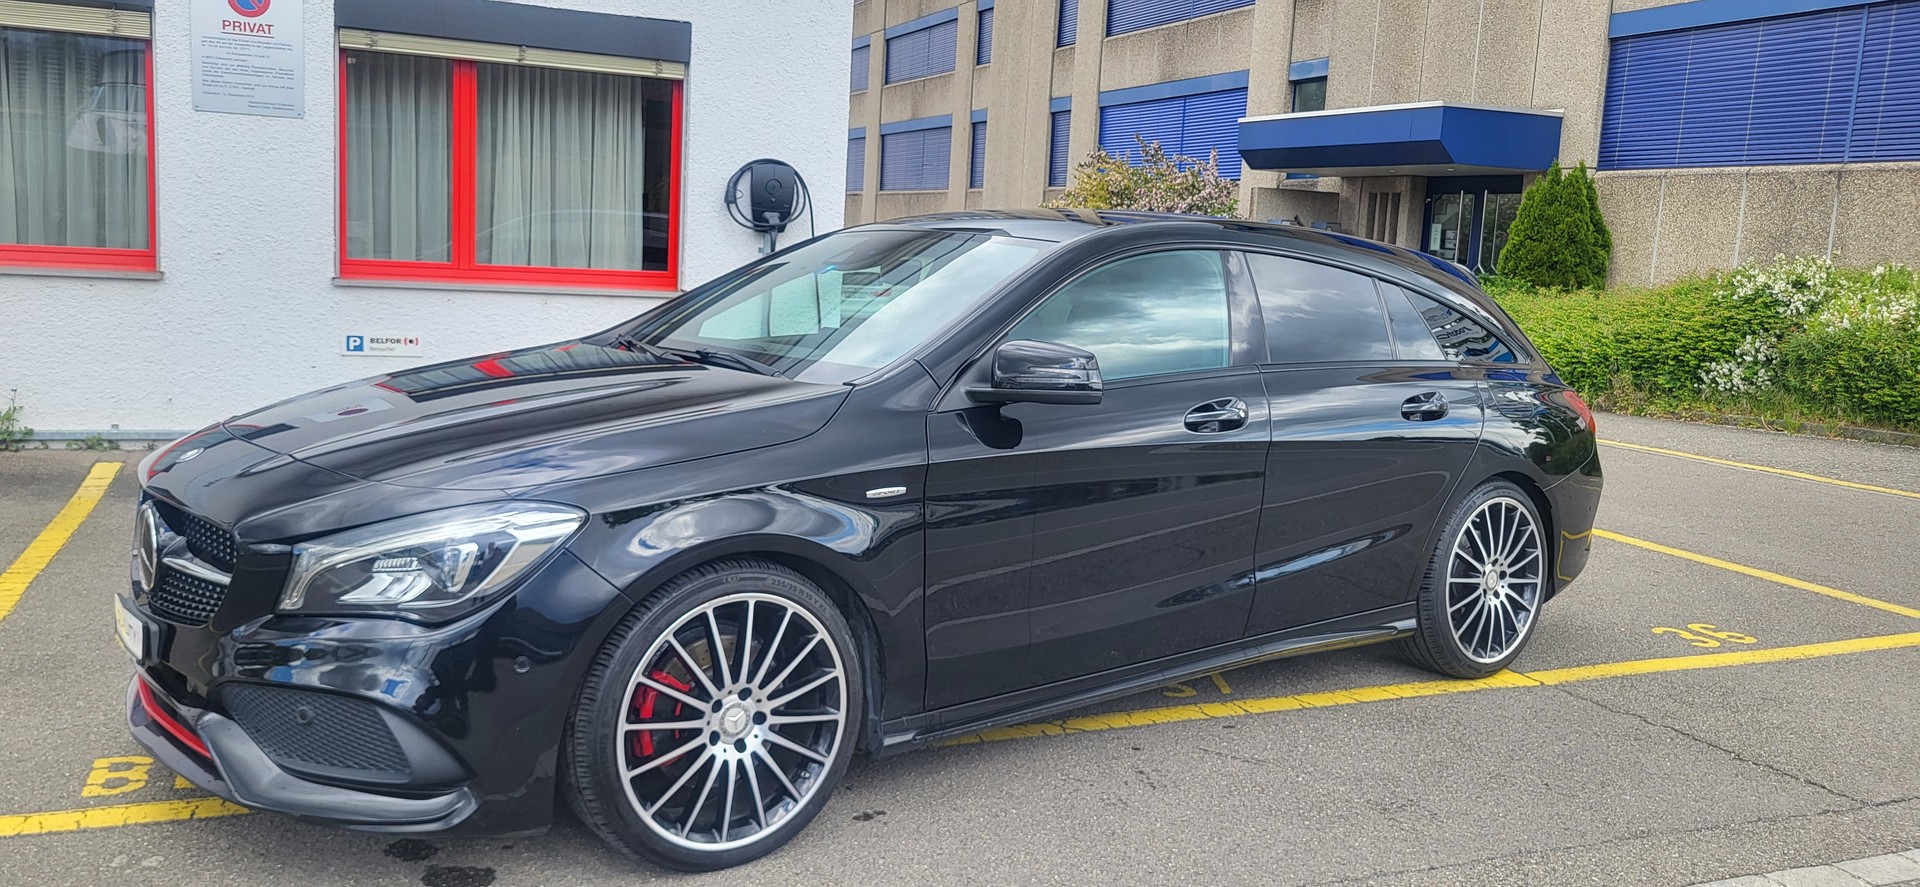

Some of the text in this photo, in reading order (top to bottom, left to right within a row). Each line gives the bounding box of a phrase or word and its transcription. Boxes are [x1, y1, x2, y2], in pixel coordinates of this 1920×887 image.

[222, 19, 274, 34] PRIVAT
[348, 336, 362, 351] P
[770, 578, 799, 593] 235/35
[798, 588, 806, 597] R
[805, 591, 814, 601] 19
[817, 601, 828, 614] XL
[1651, 623, 1758, 648] 36
